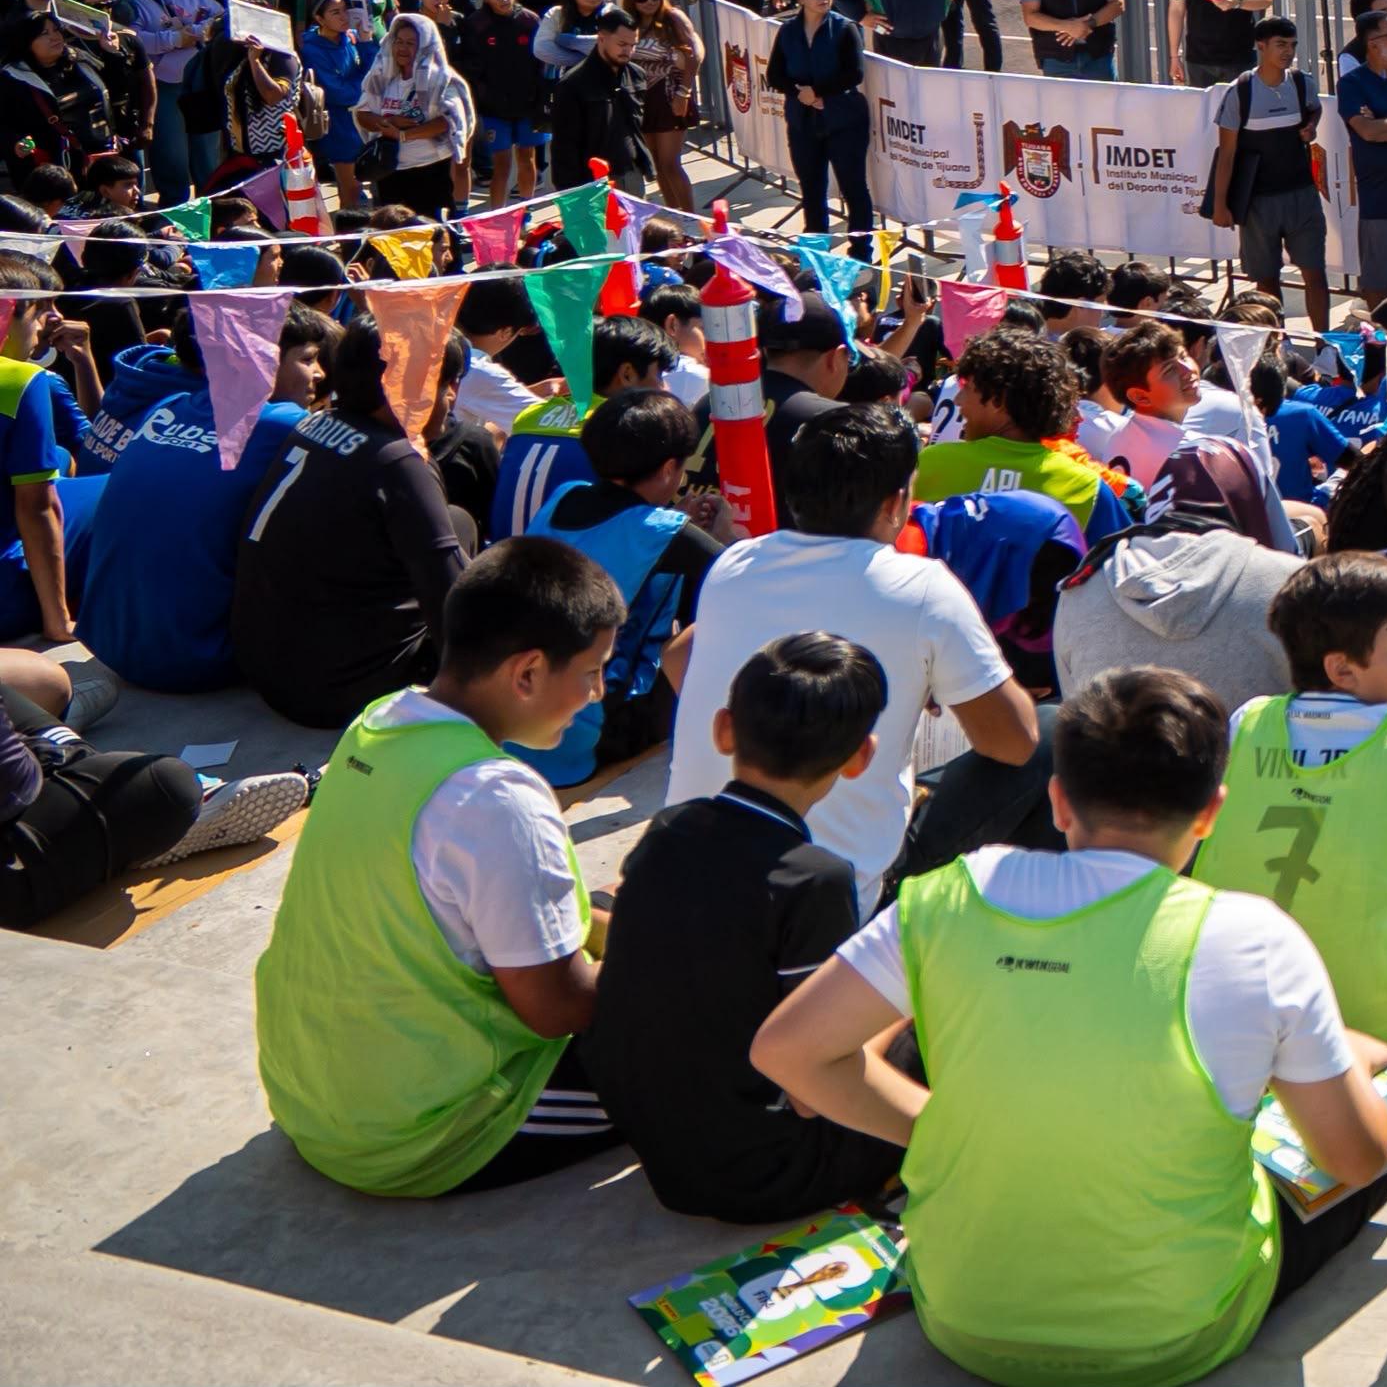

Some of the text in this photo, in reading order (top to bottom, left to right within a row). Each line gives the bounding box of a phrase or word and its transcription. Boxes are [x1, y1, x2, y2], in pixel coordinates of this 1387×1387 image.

[886, 116, 926, 144] IMDET
[936, 162, 971, 173] Tijuana
[1106, 145, 1176, 168] IMDET
[1106, 169, 1197, 183] Instituto Municipal
[1108, 181, 1206, 197] del Deporte de Tijua
[248, 446, 309, 542] 7
[1258, 806, 1327, 913] 7
